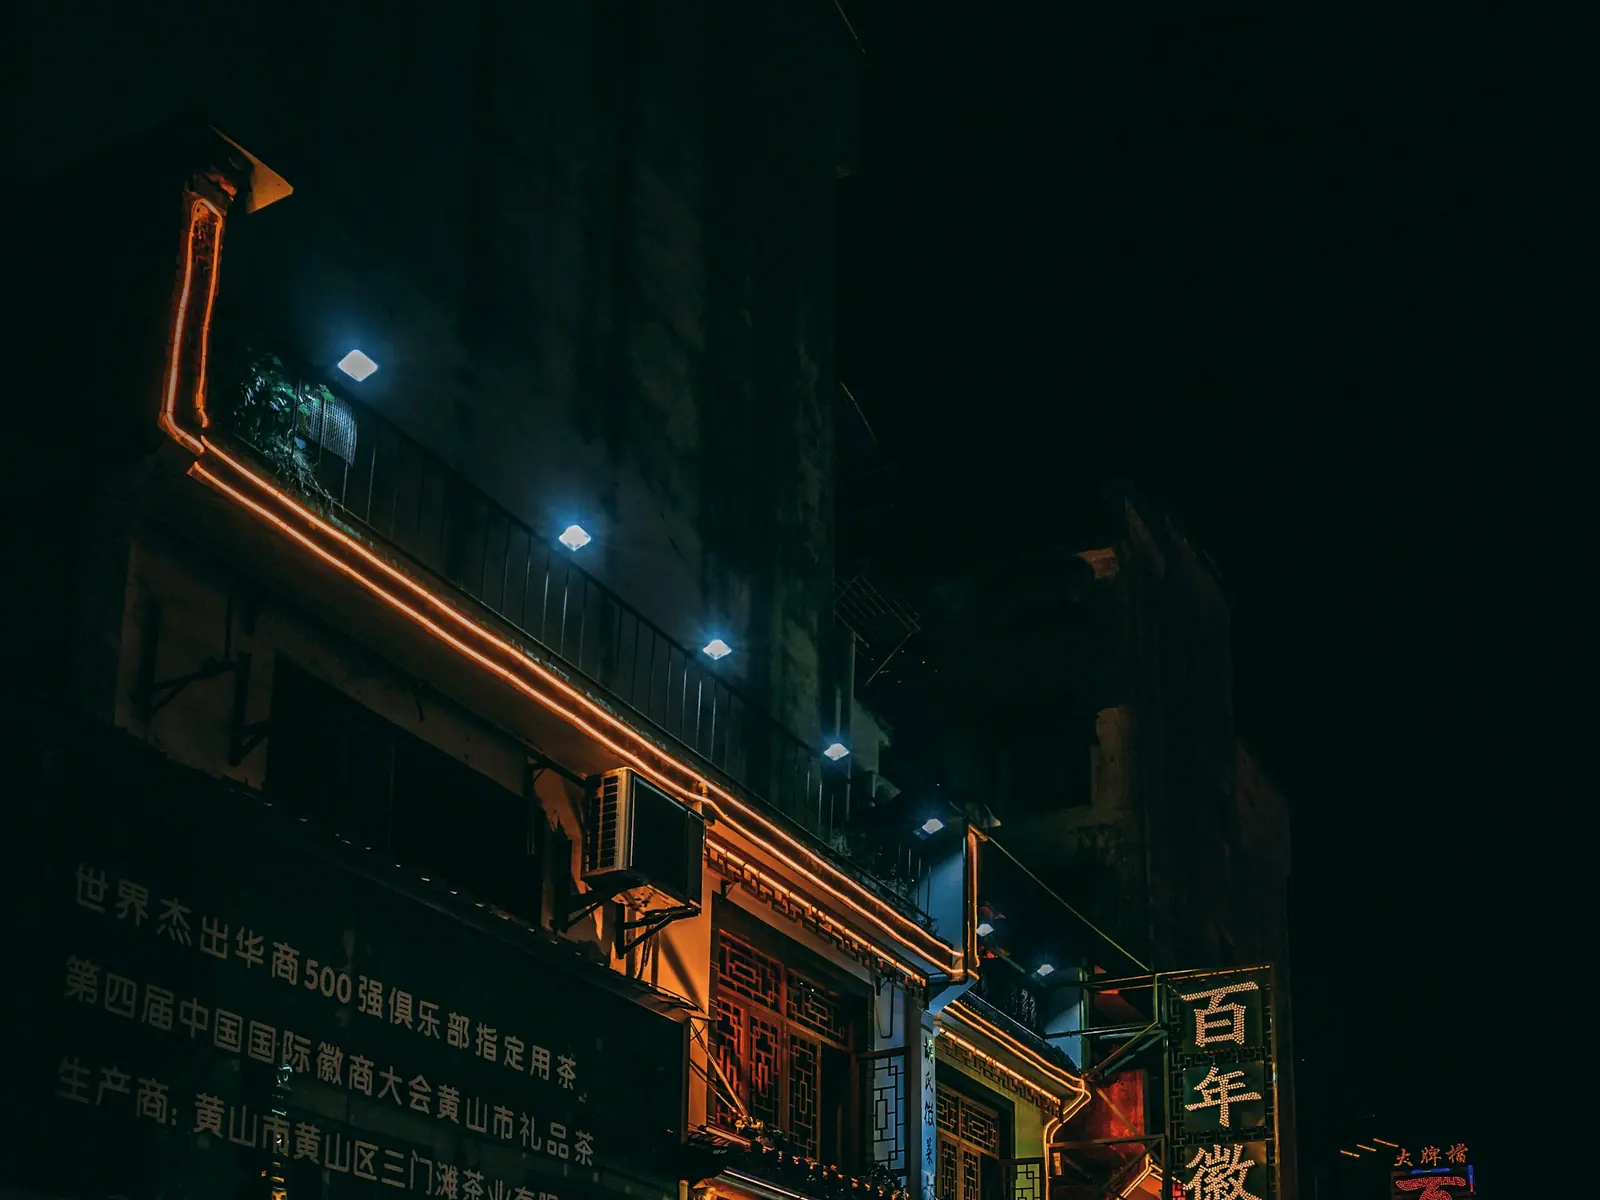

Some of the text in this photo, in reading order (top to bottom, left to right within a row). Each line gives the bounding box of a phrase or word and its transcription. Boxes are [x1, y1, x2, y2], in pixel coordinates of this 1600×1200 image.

[64, 954, 595, 1167] 第四届中国国际徽商大会黄山市礼品茶
[74, 863, 578, 1091] 世界杰出华商500强俱乐部指定用茶
